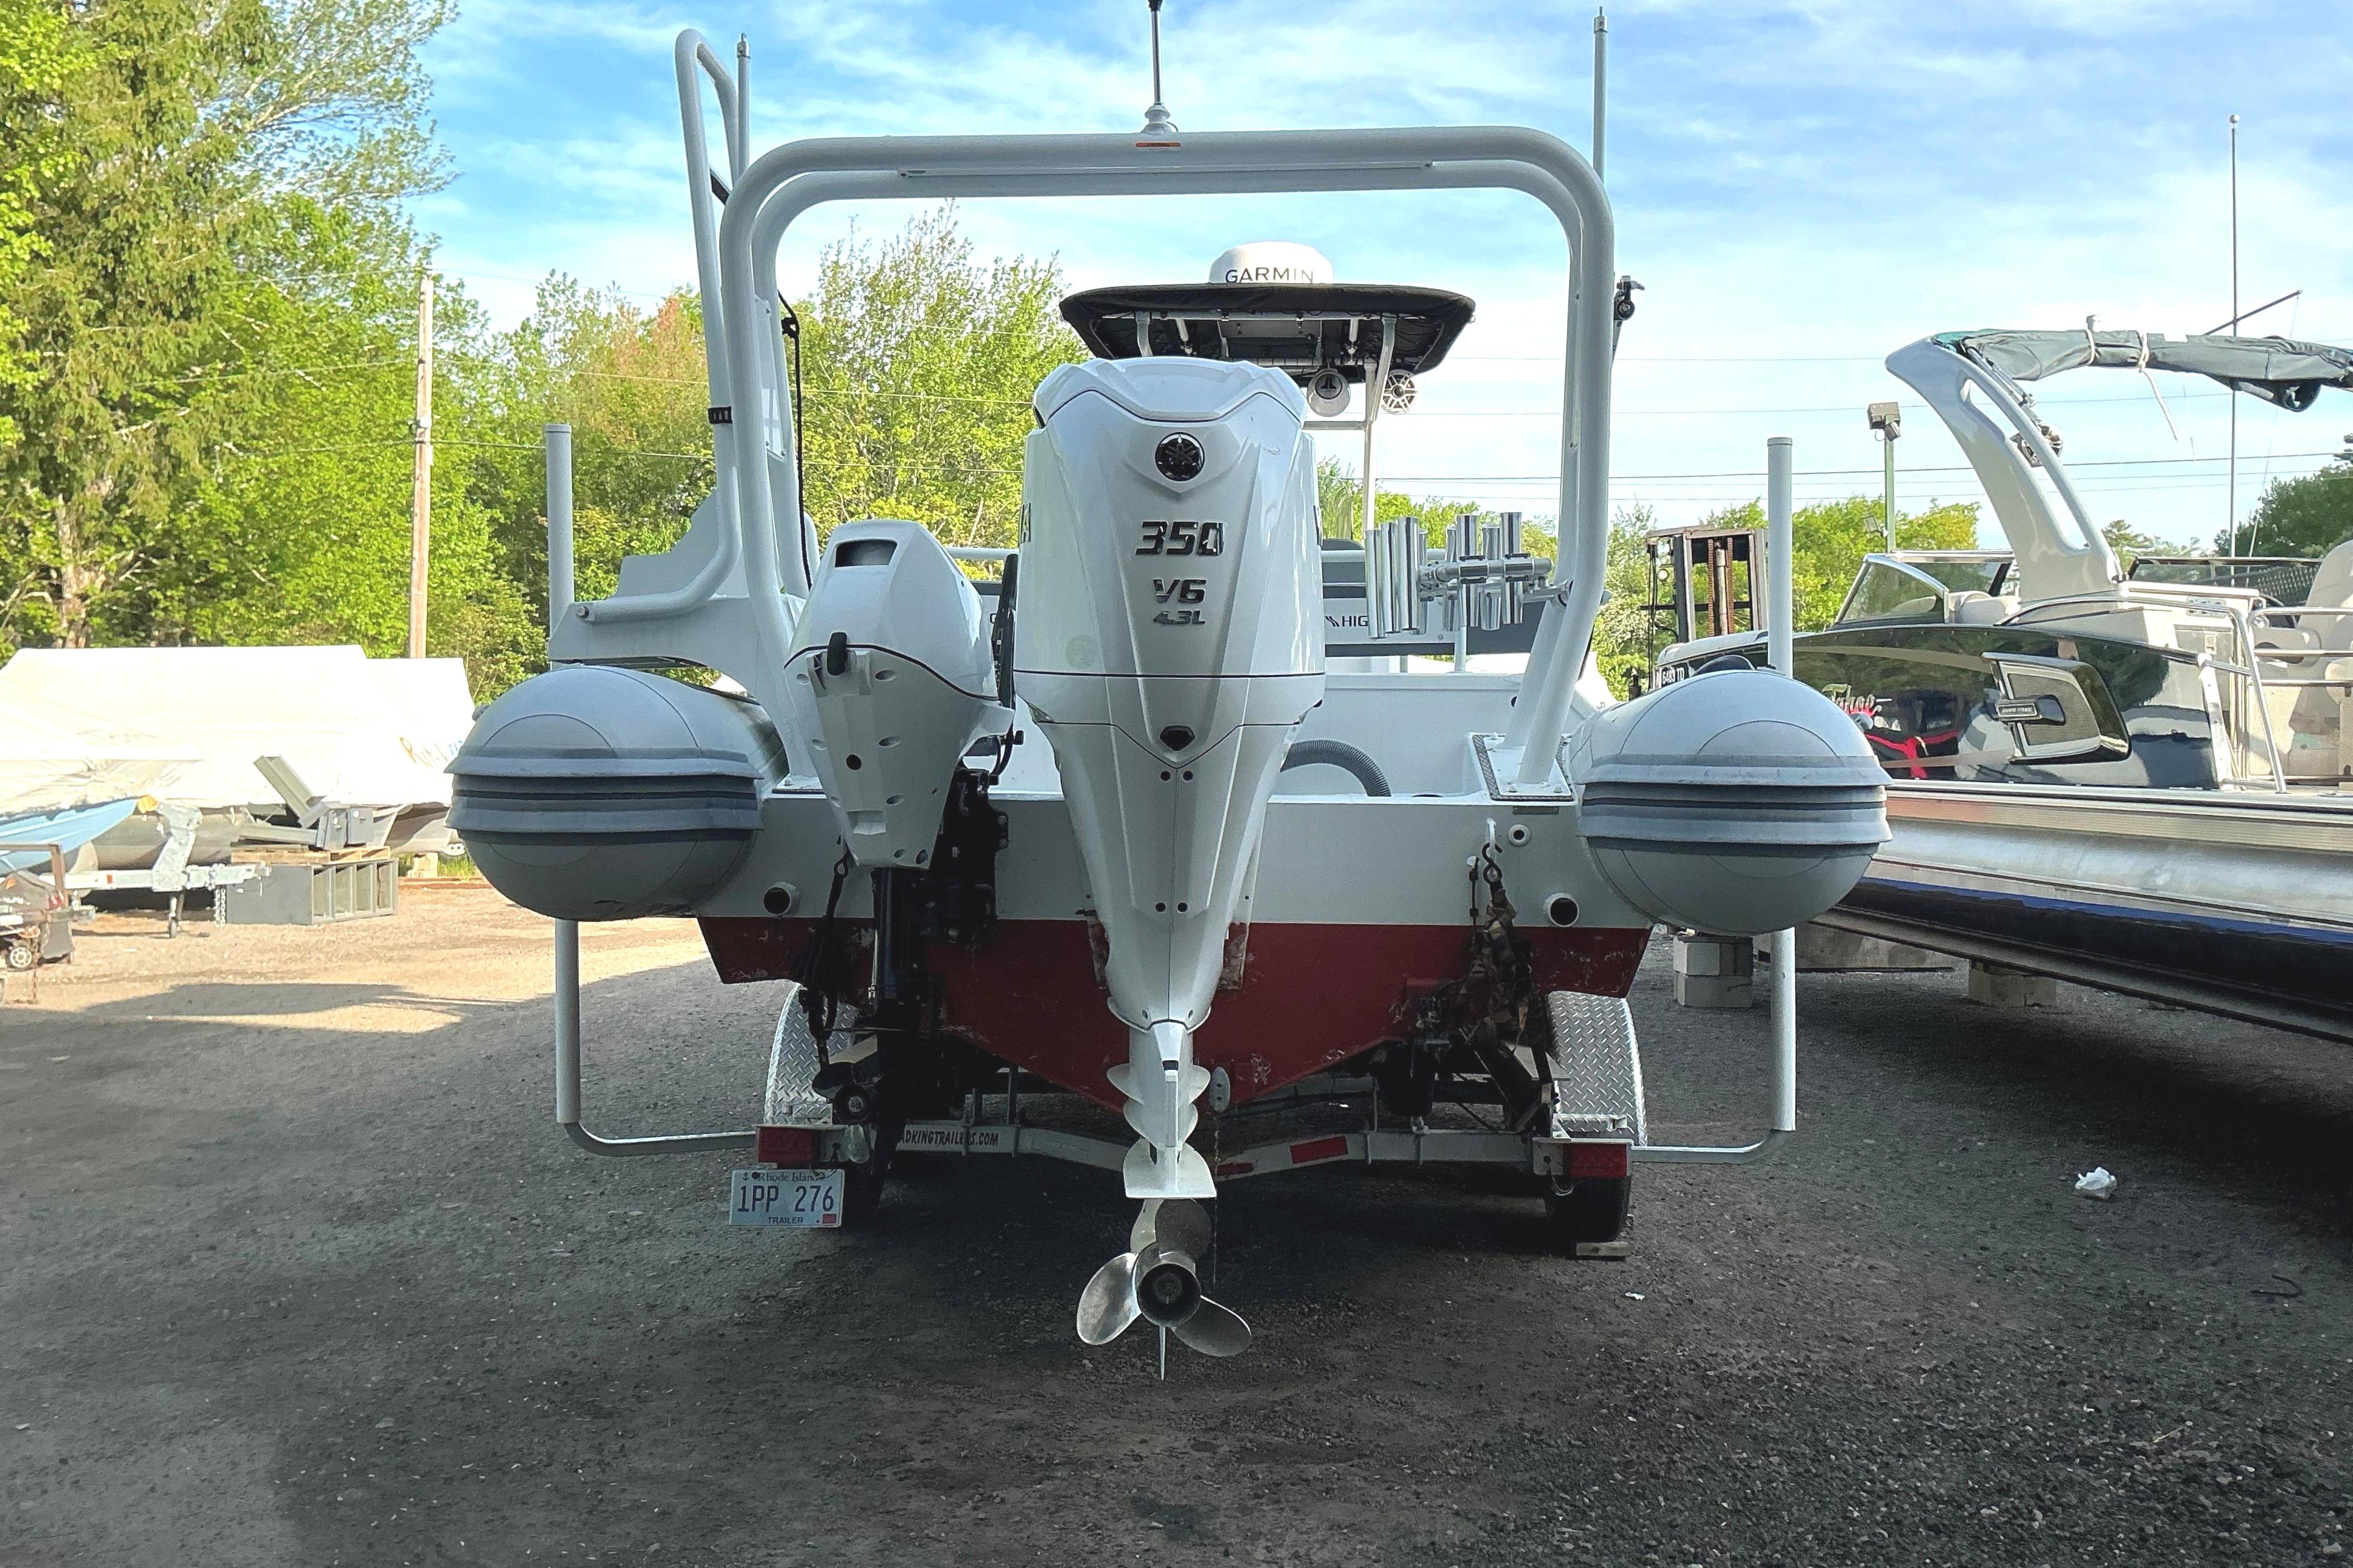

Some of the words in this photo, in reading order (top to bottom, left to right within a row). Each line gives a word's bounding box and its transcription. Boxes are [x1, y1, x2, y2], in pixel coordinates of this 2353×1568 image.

[1225, 267, 1313, 284] GARMIN
[1136, 521, 1226, 556] 350
[1153, 578, 1207, 604] V6
[1153, 609, 1207, 625] 4.3L
[758, 1172, 788, 1182] Rhode
[738, 1185, 779, 1212] 1PP
[794, 1185, 834, 1212] 276
